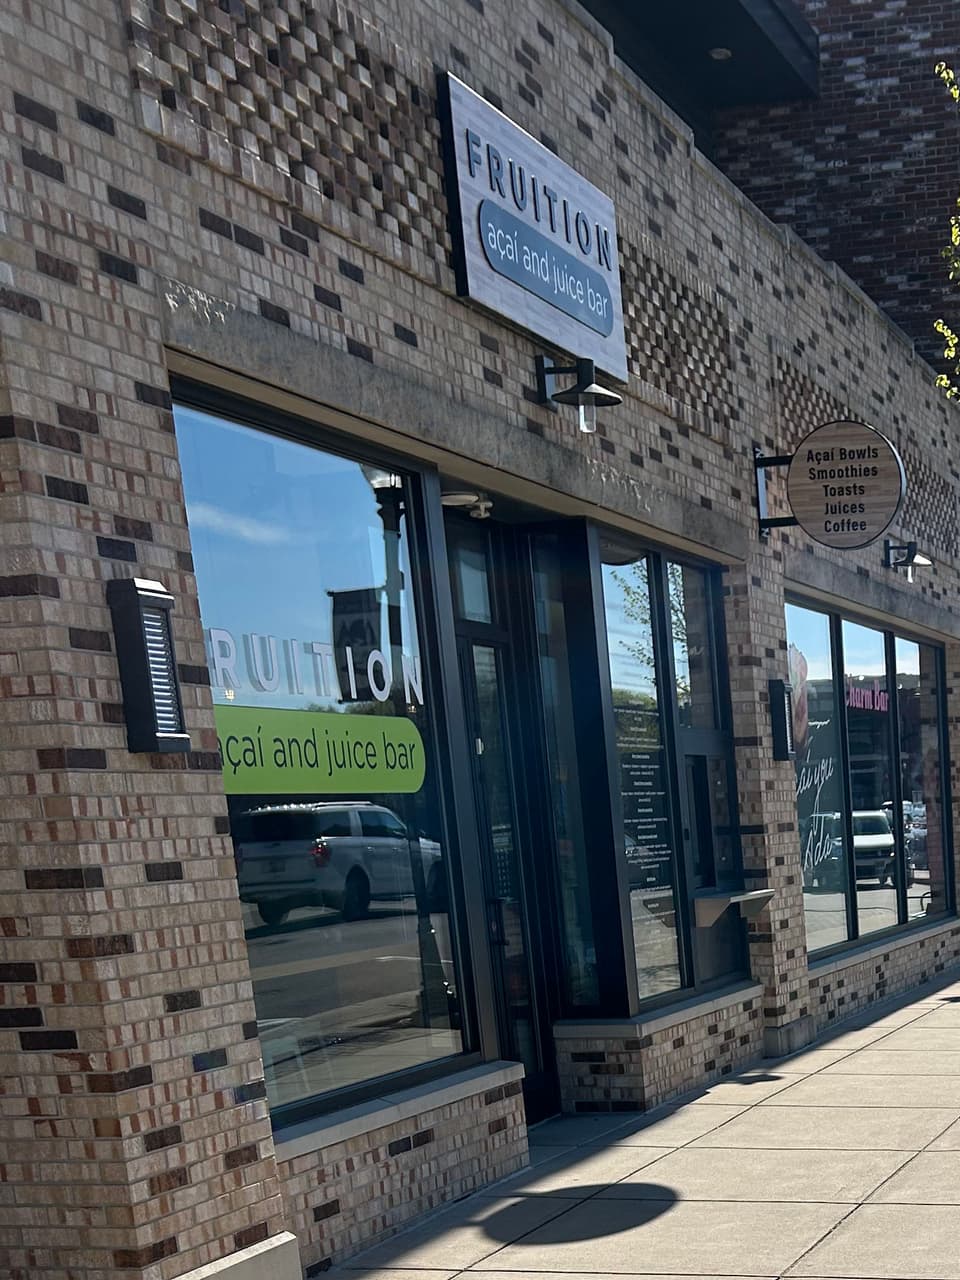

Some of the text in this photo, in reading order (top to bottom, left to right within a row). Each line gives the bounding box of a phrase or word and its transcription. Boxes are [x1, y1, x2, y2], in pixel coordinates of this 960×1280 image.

[465, 127, 612, 271] FRUITION
[487, 222, 608, 319] açaí and juice bar
[806, 445, 879, 464] Açaí Bowls
[808, 463, 878, 480] Smoothies
[823, 483, 865, 497] Toasts
[825, 501, 865, 515] Juices
[824, 519, 867, 533] Coffee
[209, 628, 424, 705] RUITION
[273, 728, 318, 769] and
[325, 730, 377, 776] juice
[383, 731, 416, 770] bar
